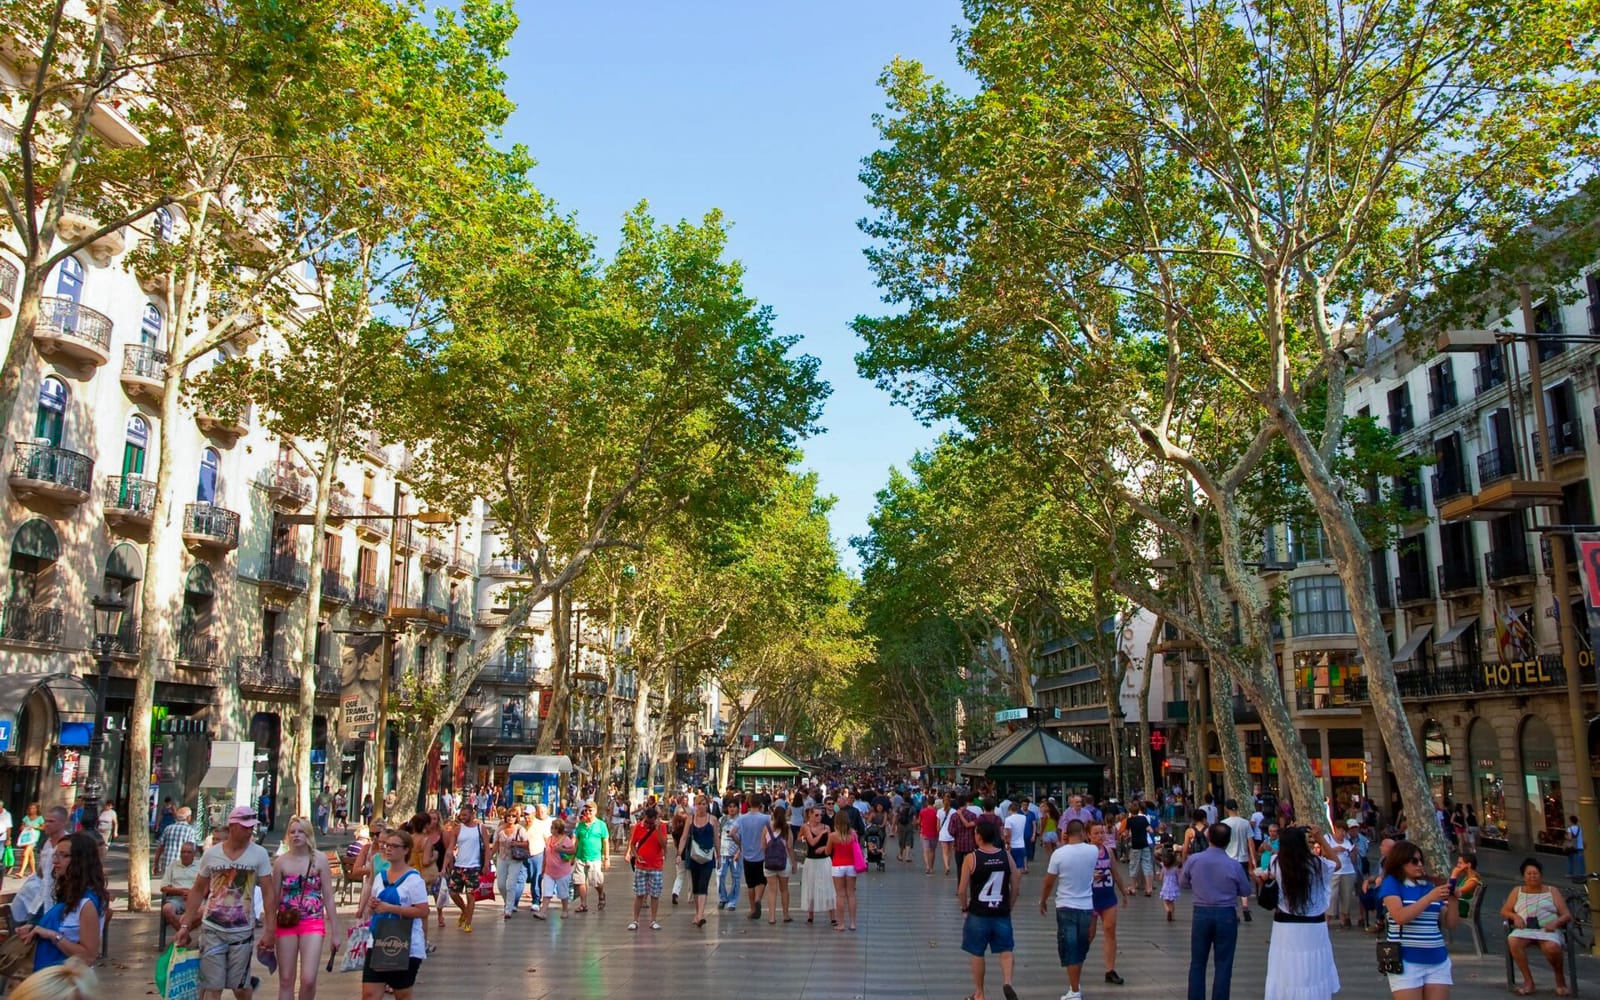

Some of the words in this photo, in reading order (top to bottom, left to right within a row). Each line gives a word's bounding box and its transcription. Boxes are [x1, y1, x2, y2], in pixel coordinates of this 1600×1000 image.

[1484, 659, 1551, 686] HOTEL
[345, 707, 368, 716] TRAMA
[978, 870, 1004, 902] 4
